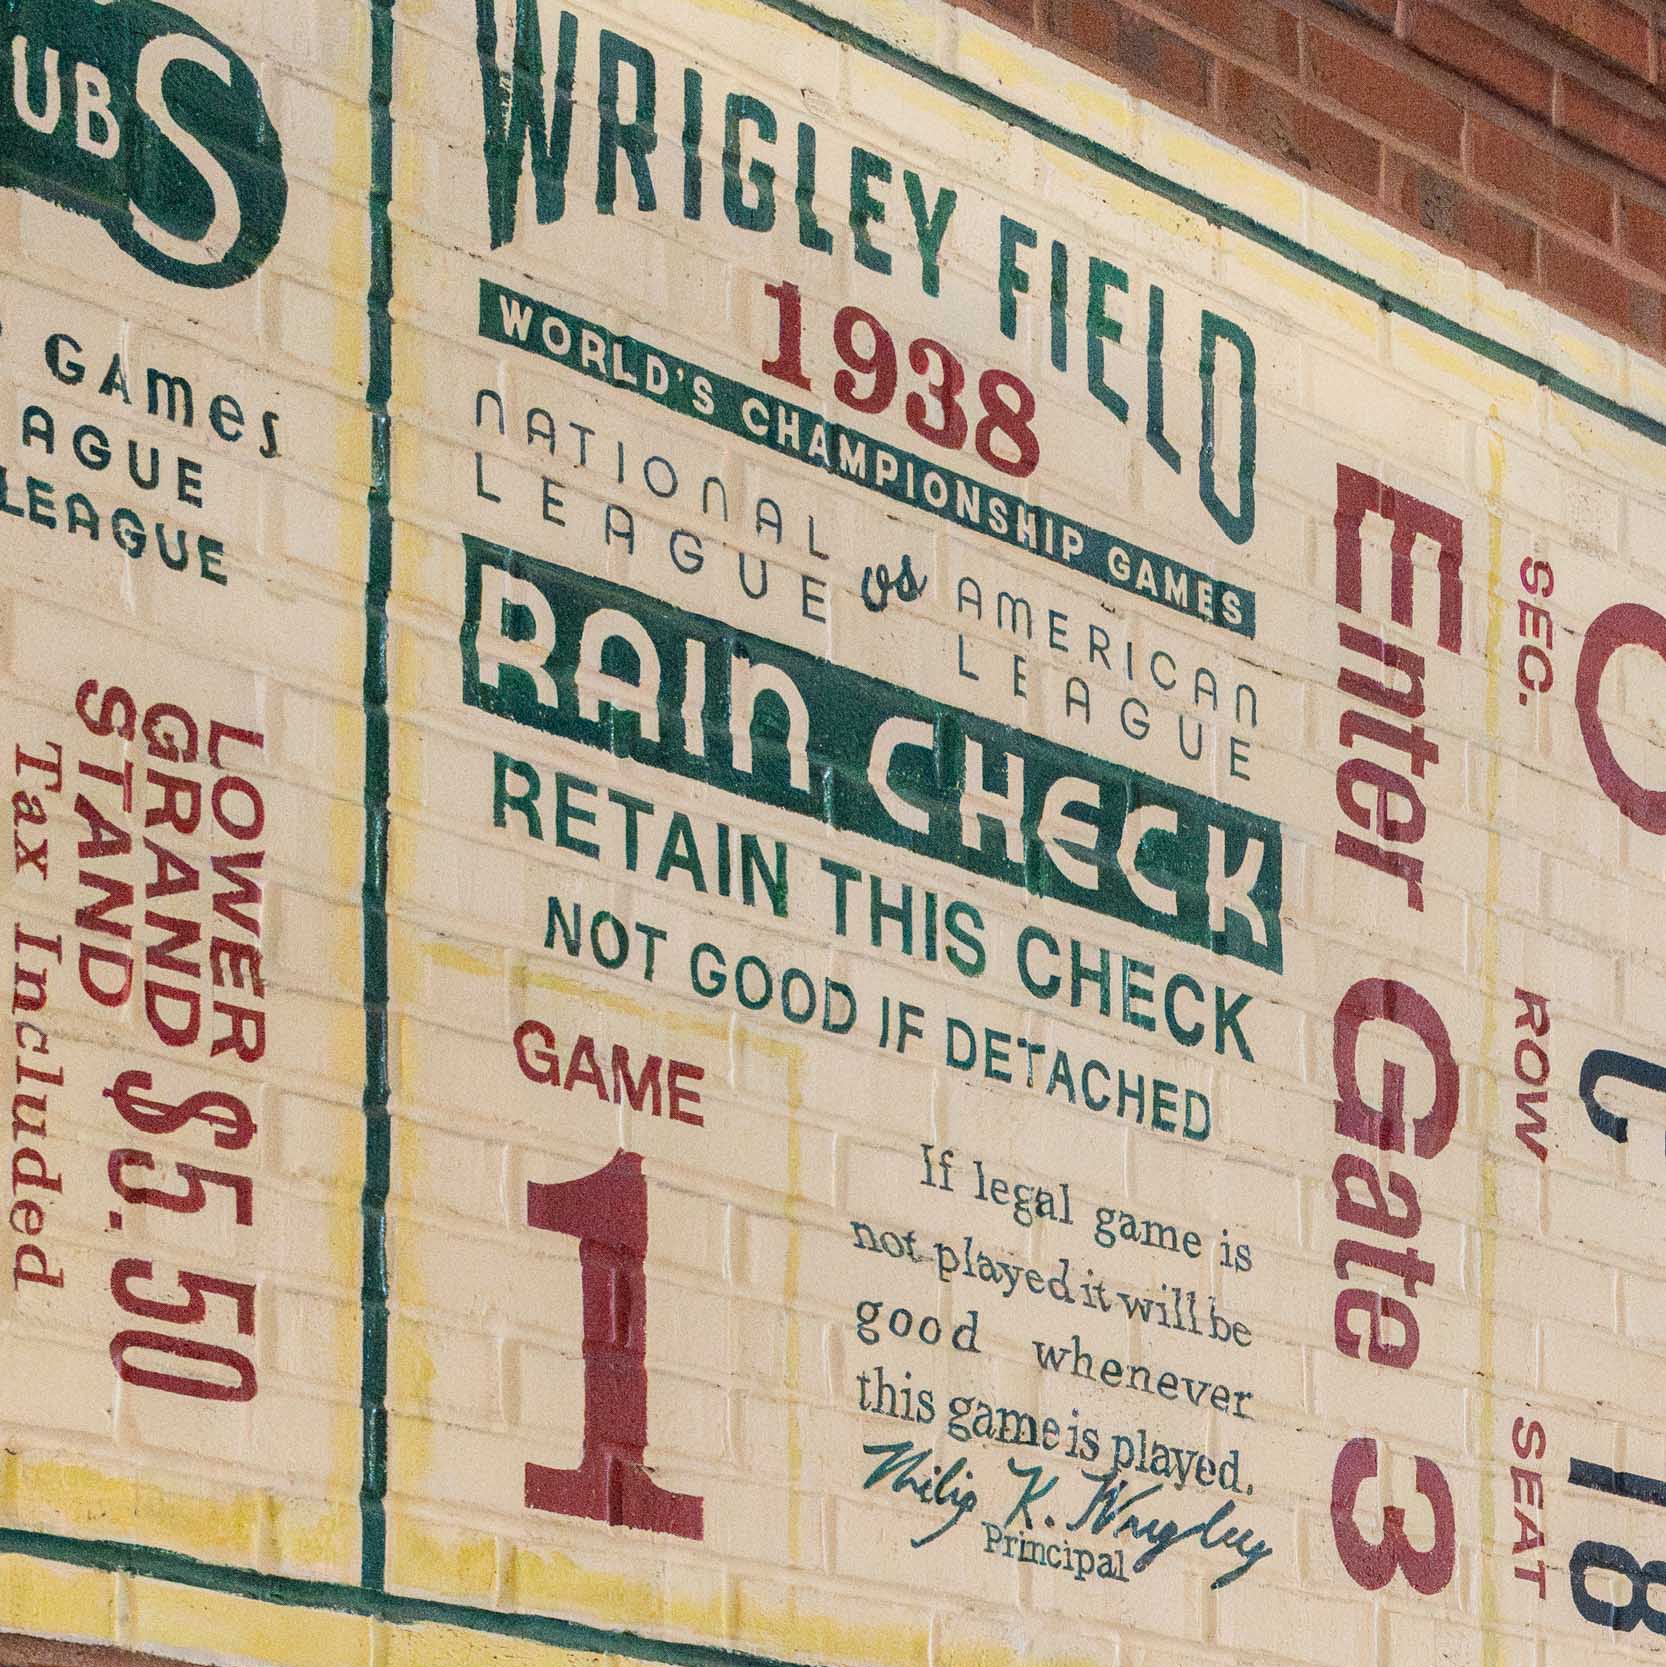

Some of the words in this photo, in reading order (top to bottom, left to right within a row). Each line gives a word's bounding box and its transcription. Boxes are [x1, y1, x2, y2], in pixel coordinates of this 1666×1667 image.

[476, 0, 957, 298] WRIGLEY
[999, 215, 1257, 545] FIELD
[499, 295, 716, 414] WORLD'S
[741, 396, 1083, 563] CHAMPIONSHIP
[1108, 547, 1243, 624] GAMES
[761, 281, 1040, 478] 1938
[0, 466, 228, 586] LEAGUE
[476, 389, 829, 561] NATIONAL
[476, 452, 828, 624] LEAGUE
[957, 577, 1258, 727] AMERICAN
[957, 634, 1251, 781] LEAGUE
[1336, 462, 1463, 912] Enter
[1519, 556, 1554, 707] SEC.
[15, 741, 63, 881] Tax
[75, 679, 136, 1008] STAND
[478, 562, 809, 794] RAIN
[870, 717, 1269, 948] CHECK
[141, 703, 201, 1047] GRAND
[208, 719, 266, 1063] LOWER
[493, 752, 787, 917] RETAIN
[820, 857, 987, 978] THIS
[1017, 927, 1254, 1063] CHECK
[12, 923, 65, 1293] Included
[513, 1019, 705, 1127] GAME
[544, 896, 667, 981] NOT
[690, 941, 857, 1036] GOOD
[880, 996, 925, 1055] IF
[947, 1018, 1212, 1142] DETACHED
[1512, 987, 1550, 1160] ROW
[102, 1070, 258, 1403] $5.50
[920, 1143, 954, 1191] If
[973, 1161, 1073, 1227] legal
[1095, 1207, 1202, 1258] game
[1220, 1229, 1252, 1272] is
[1334, 977, 1459, 1371] Gate
[525, 1147, 705, 1542] 1
[850, 1220, 919, 1262] not
[933, 1236, 1075, 1304] played
[1080, 1269, 1111, 1312] it
[1116, 1285, 1202, 1336] will
[1209, 1298, 1252, 1347] be
[857, 1300, 981, 1353] good
[1033, 1335, 1255, 1420] whenever
[857, 1366, 936, 1424] this
[948, 1396, 1060, 1450] game
[1066, 1407, 1099, 1460] is
[1112, 1430, 1253, 1496] played.
[1330, 1436, 1456, 1595] 3
[1510, 1415, 1546, 1599] SEAT
[981, 1521, 1129, 1582] Principal
